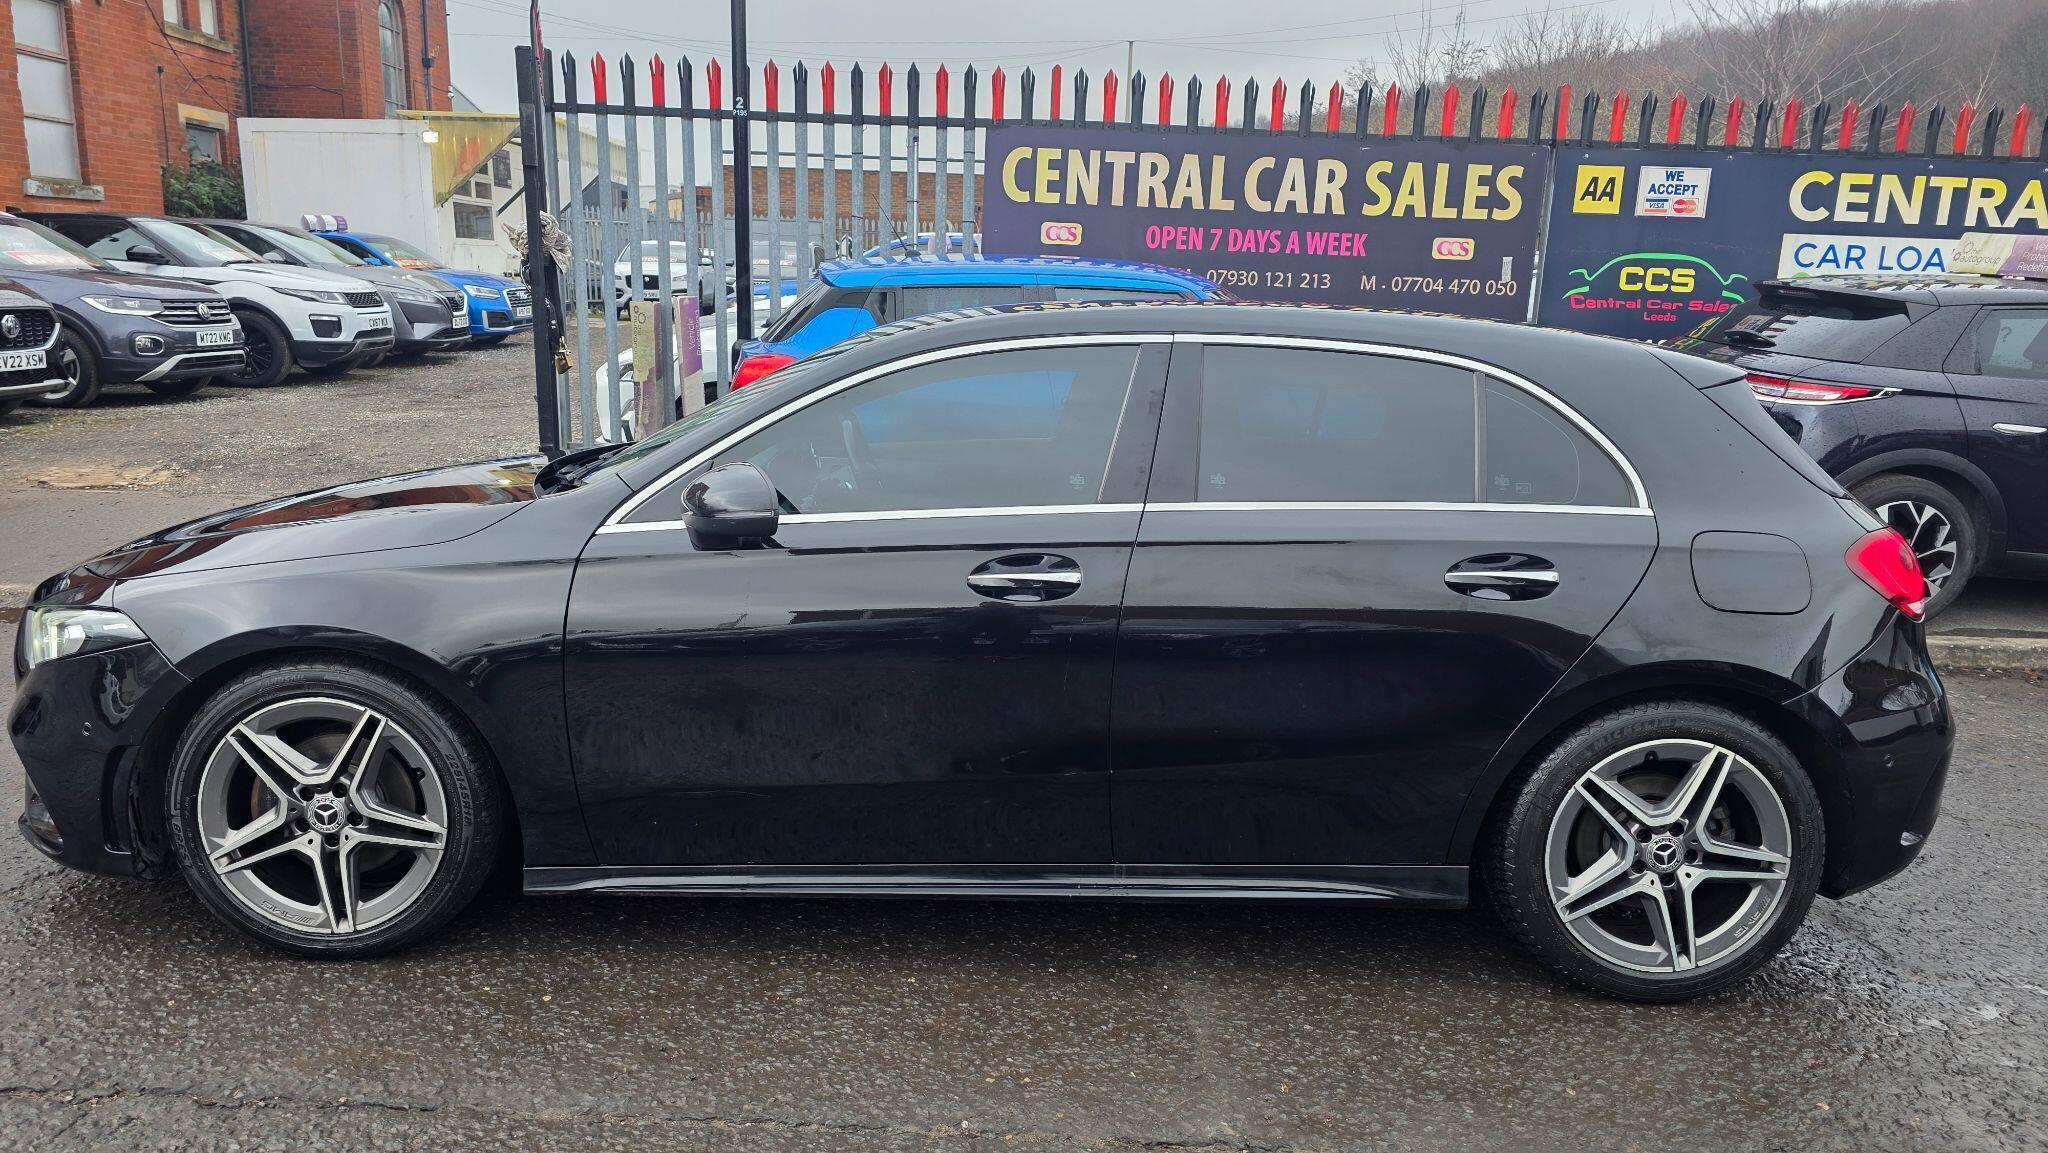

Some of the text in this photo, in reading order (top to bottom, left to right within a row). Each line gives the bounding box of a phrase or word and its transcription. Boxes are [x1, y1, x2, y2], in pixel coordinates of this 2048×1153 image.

[736, 96, 744, 109] 2
[1002, 146, 1525, 221] CENTRAL CAR SALES
[1665, 170, 1685, 182] WE
[1580, 176, 1616, 202] AA
[1648, 183, 1698, 196] ACCEPT
[1789, 170, 2048, 230] CENTRA
[1045, 225, 1078, 242] CCS
[1146, 225, 1368, 257] OPEN 7 DAYS A WEEK
[1436, 240, 1470, 257] CCS
[1793, 242, 1950, 273] CAR LOA
[1206, 269, 1259, 286] 07930
[1265, 271, 1292, 288] 121
[1300, 272, 1331, 289] 213
[1391, 276, 1444, 294] 07704
[1448, 278, 1480, 294] 470
[1485, 280, 1517, 296] 050
[1619, 266, 1696, 293] CCS
[1569, 294, 1641, 310] Central
[1646, 299, 1683, 311] Car
[1643, 312, 1677, 322] Leeds
[25, 353, 45, 367] XSM
